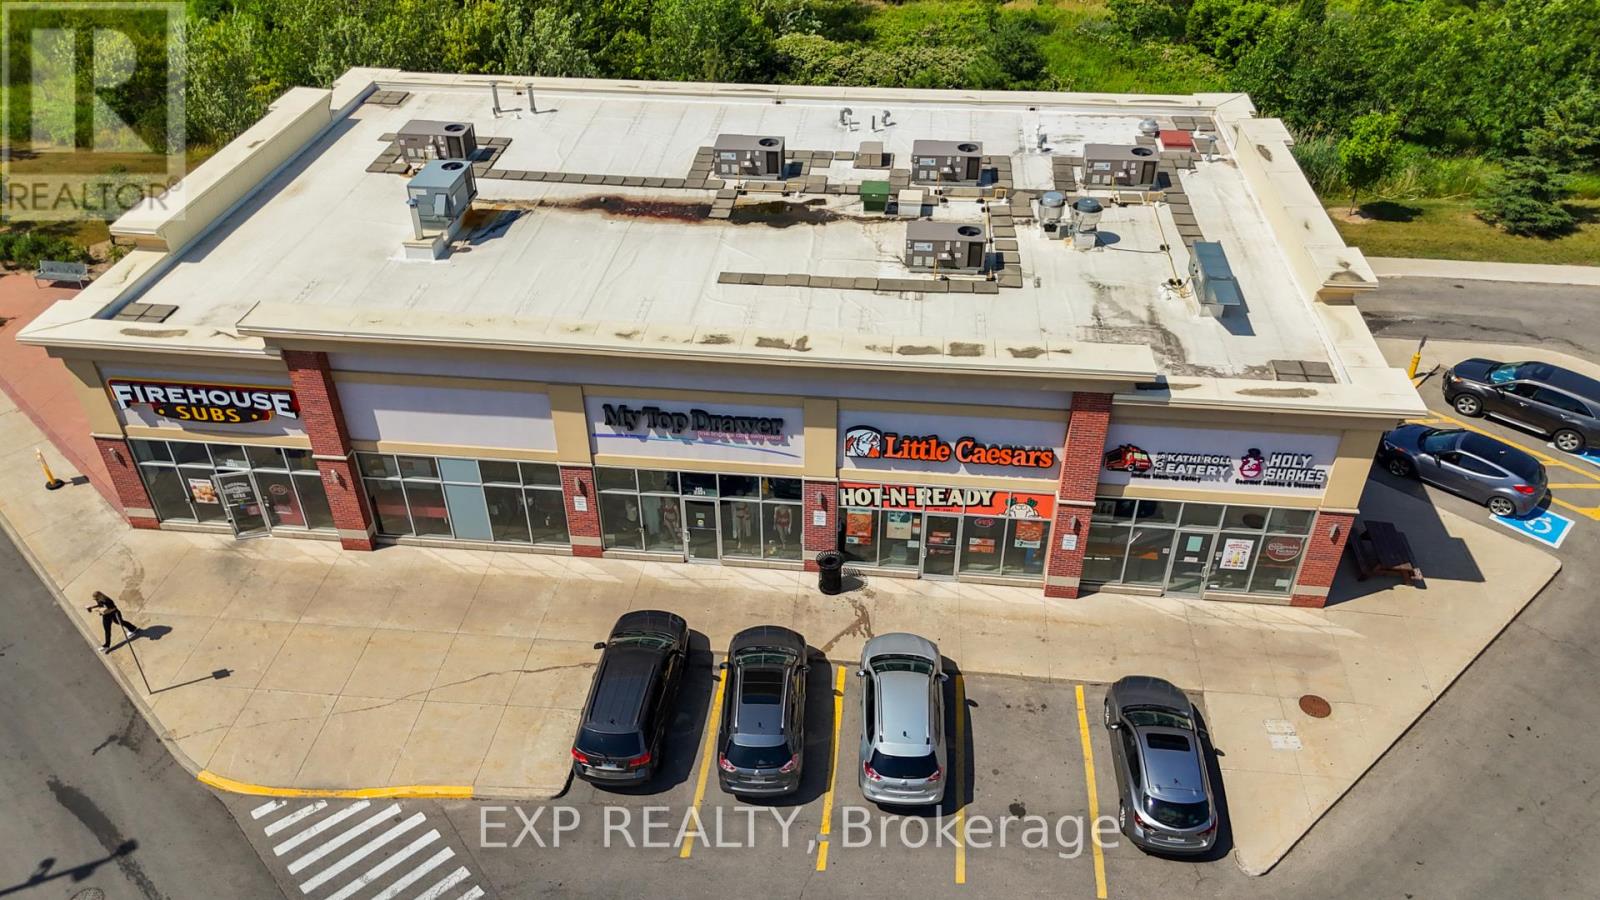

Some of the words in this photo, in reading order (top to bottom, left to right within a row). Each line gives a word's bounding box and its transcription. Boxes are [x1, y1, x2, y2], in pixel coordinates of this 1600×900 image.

[111, 384, 297, 419] FIREHOUSE
[176, 406, 241, 423] SUBS
[602, 404, 642, 431] My
[642, 406, 689, 434] Top
[690, 409, 784, 435] Drawer
[884, 434, 951, 462] Little
[955, 438, 1054, 468] Caesars
[1167, 453, 1201, 464] KATHI
[1203, 455, 1232, 465] ROLL
[1165, 463, 1230, 476] EATERY
[1269, 453, 1312, 469] HOLY
[1266, 467, 1326, 483] SHAKES
[840, 487, 996, 507] HOT-N-READY
